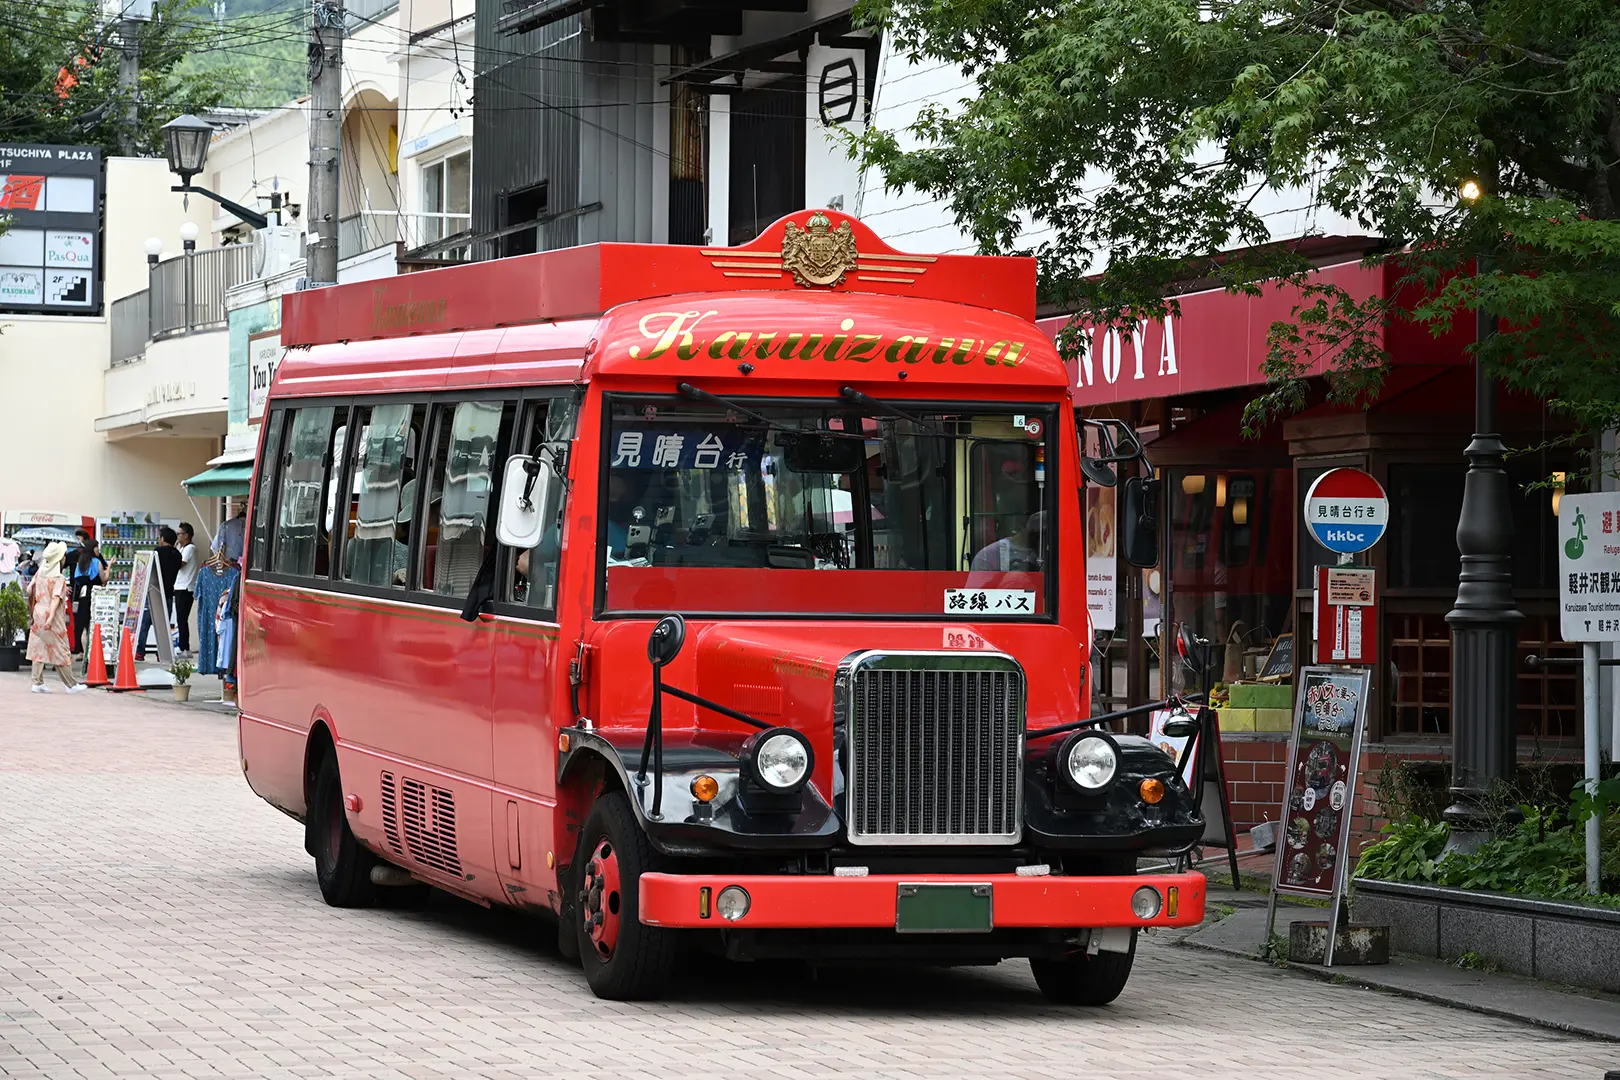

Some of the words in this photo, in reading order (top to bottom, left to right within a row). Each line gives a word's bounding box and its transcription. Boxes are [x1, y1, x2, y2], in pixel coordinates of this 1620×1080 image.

[0, 148, 52, 159] TSUCHIYA
[58, 150, 93, 160] PLAZA
[0, 174, 45, 211] 酒
[48, 250, 89, 262] PasQua
[52, 276, 64, 284] 2F
[628, 309, 1029, 368] Karuizawa
[253, 364, 267, 390] You
[612, 431, 748, 469] 見晴台行
[1317, 505, 1376, 518] 見晴台行き
[1327, 530, 1364, 542] kkbc
[1568, 571, 1620, 594] 軽井沢観光
